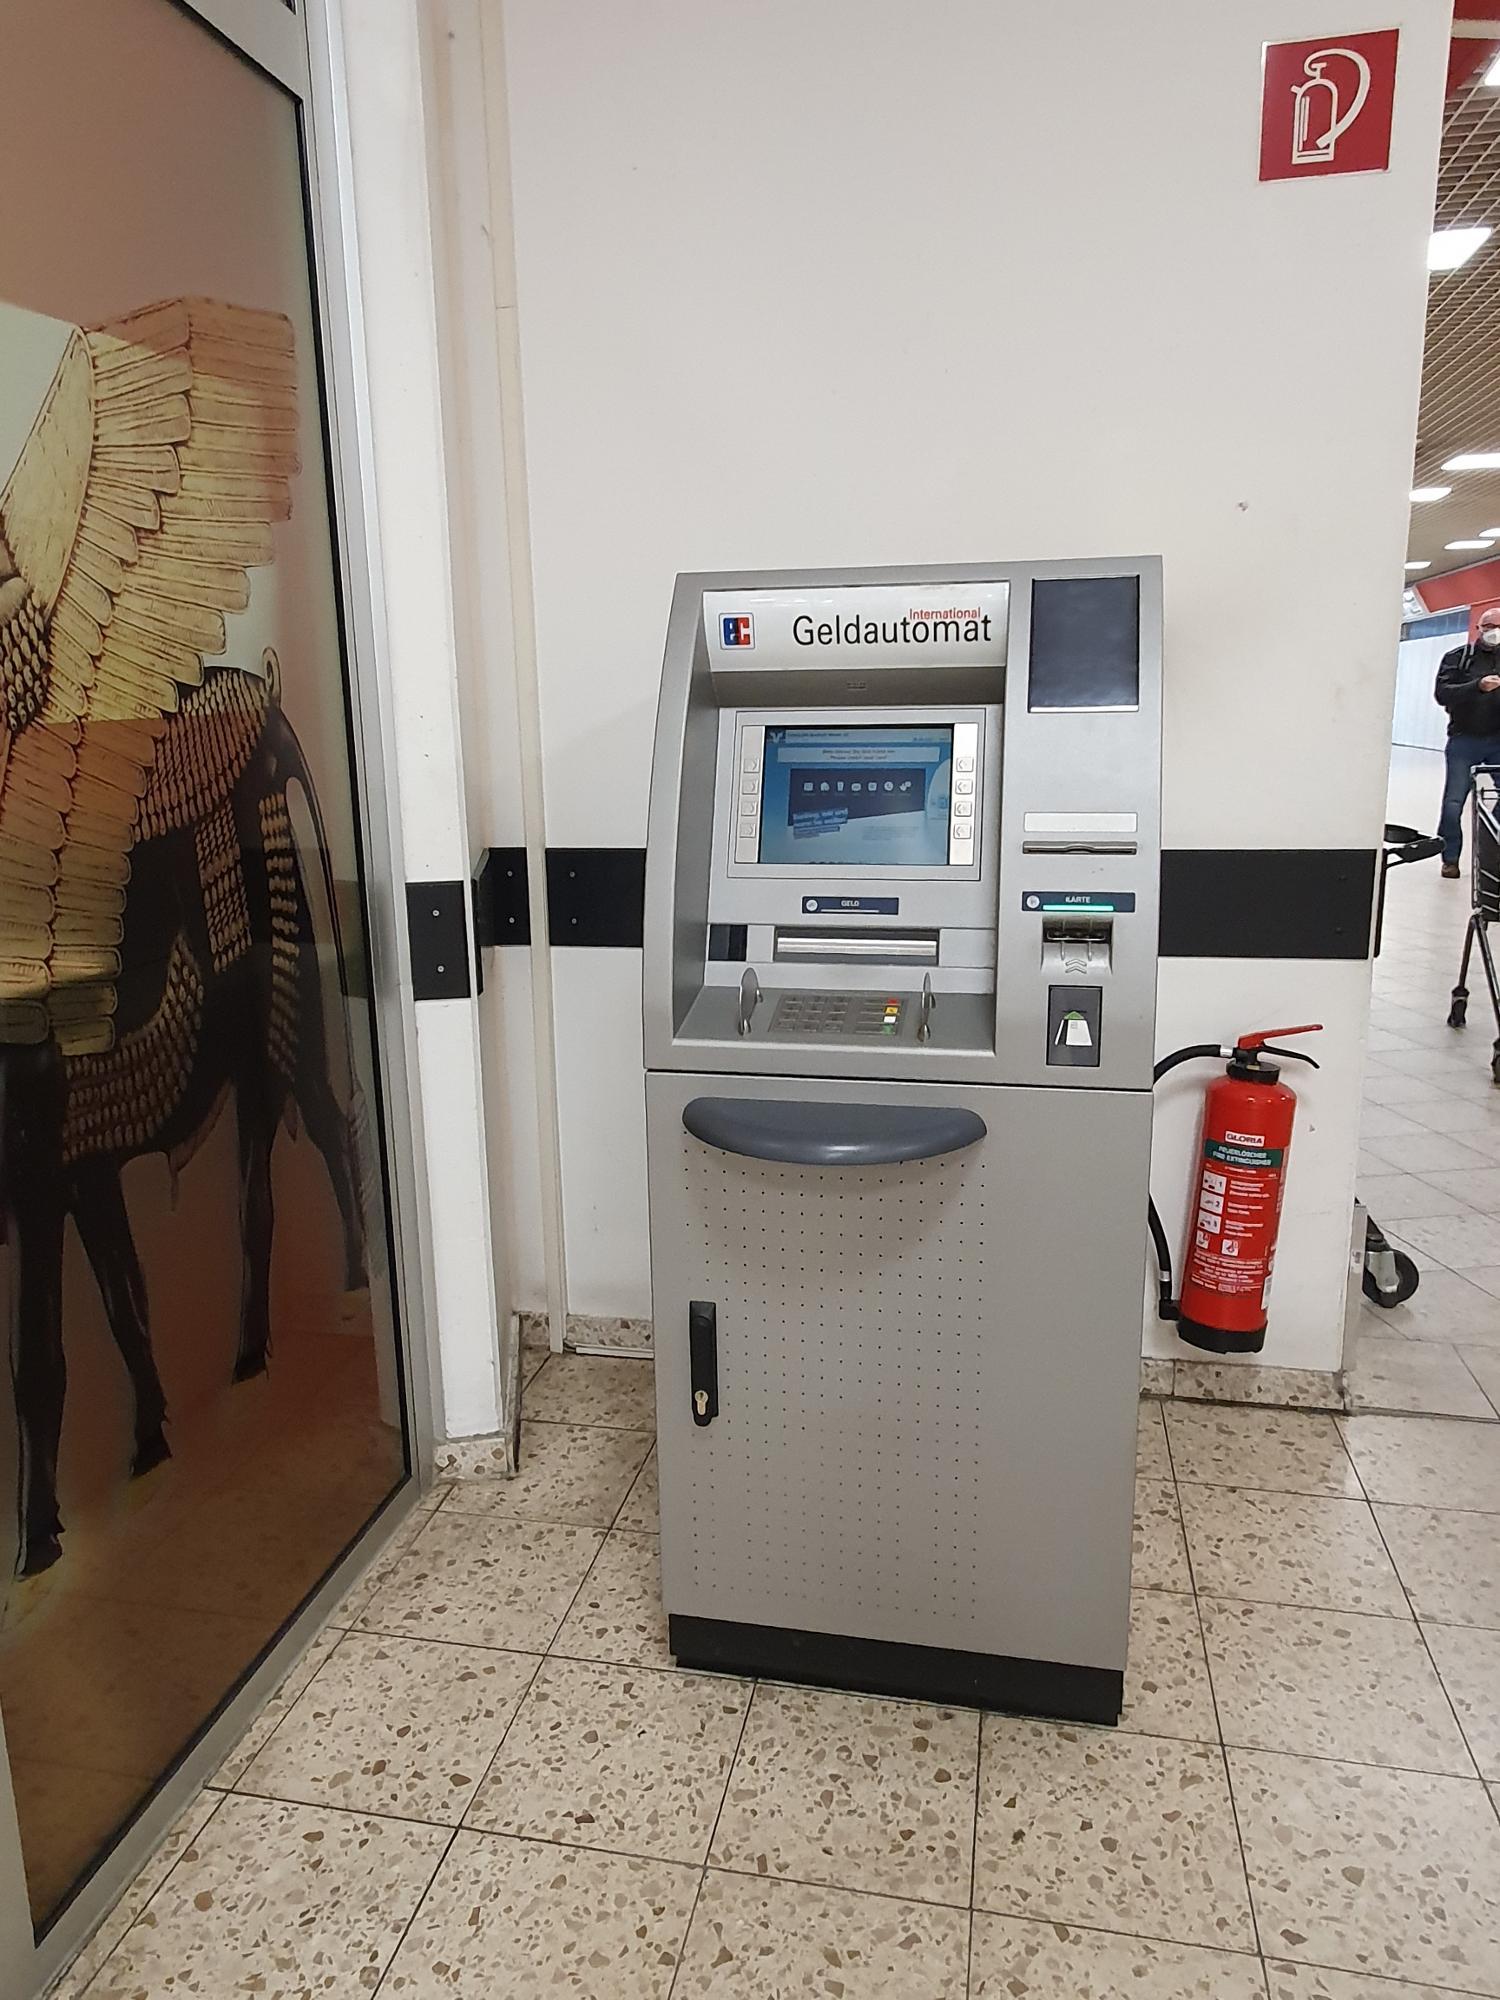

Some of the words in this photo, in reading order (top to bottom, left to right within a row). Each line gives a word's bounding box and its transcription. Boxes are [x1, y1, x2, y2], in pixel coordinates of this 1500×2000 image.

[909, 607, 981, 620] International
[793, 614, 992, 646] Geldautomat
[1065, 896, 1091, 904] KARTE
[1226, 1133, 1263, 1144] GLORIA
